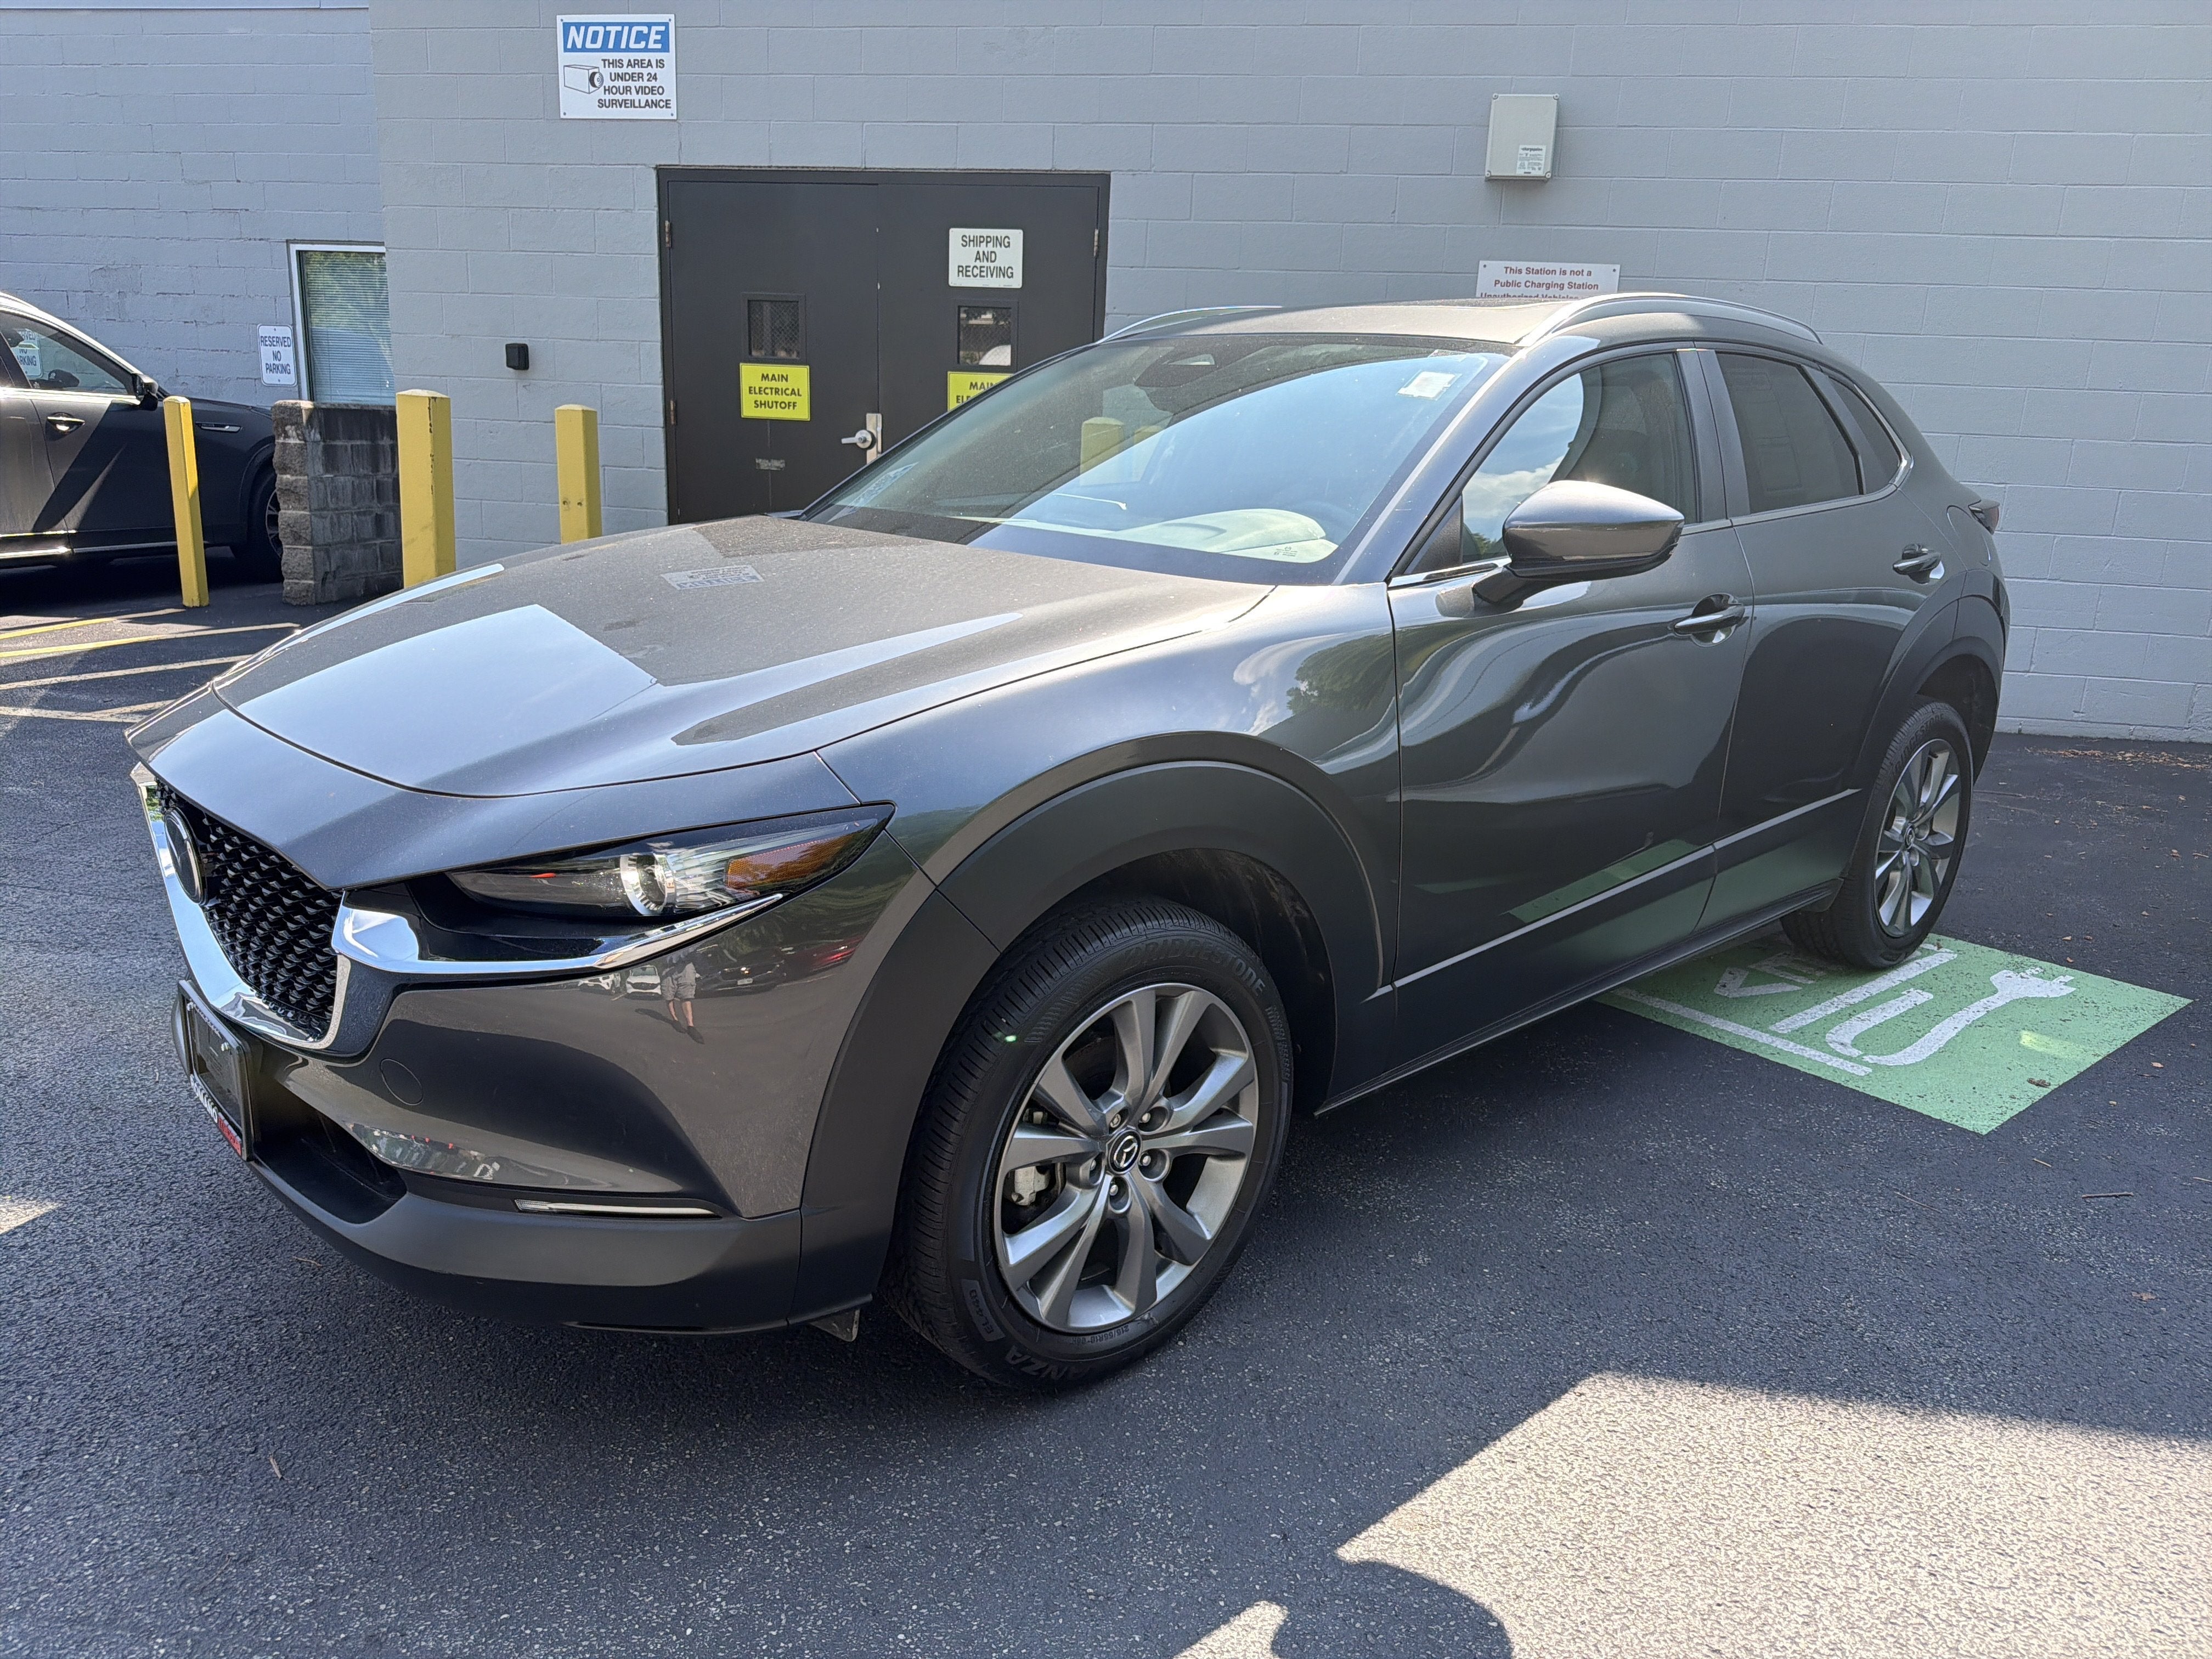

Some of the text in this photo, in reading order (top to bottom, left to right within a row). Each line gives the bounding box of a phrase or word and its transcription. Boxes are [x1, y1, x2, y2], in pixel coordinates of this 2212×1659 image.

[567, 26, 665, 49] NOTICE
[601, 59, 665, 69] THIS AREA IS
[610, 72, 658, 82] UNDER 24
[603, 86, 665, 95] HOUR VIDEO
[597, 99, 672, 109] SURVEILLANCE
[961, 235, 1011, 248] SHIPPING
[974, 251, 997, 263] AND
[957, 265, 1014, 279] RECEIVING
[1504, 266, 1522, 274] This
[1525, 267, 1556, 275] Station
[1559, 268, 1567, 276] is
[1570, 268, 1584, 276] not
[1494, 280, 1599, 291] Public Charging Station
[261, 336, 291, 347] RESERVED
[272, 350, 281, 362] NO
[265, 363, 291, 374] PARKING
[761, 373, 788, 382] MAIN
[748, 386, 802, 397] ELECTRICAL
[754, 400, 797, 410] SHUTOFF
